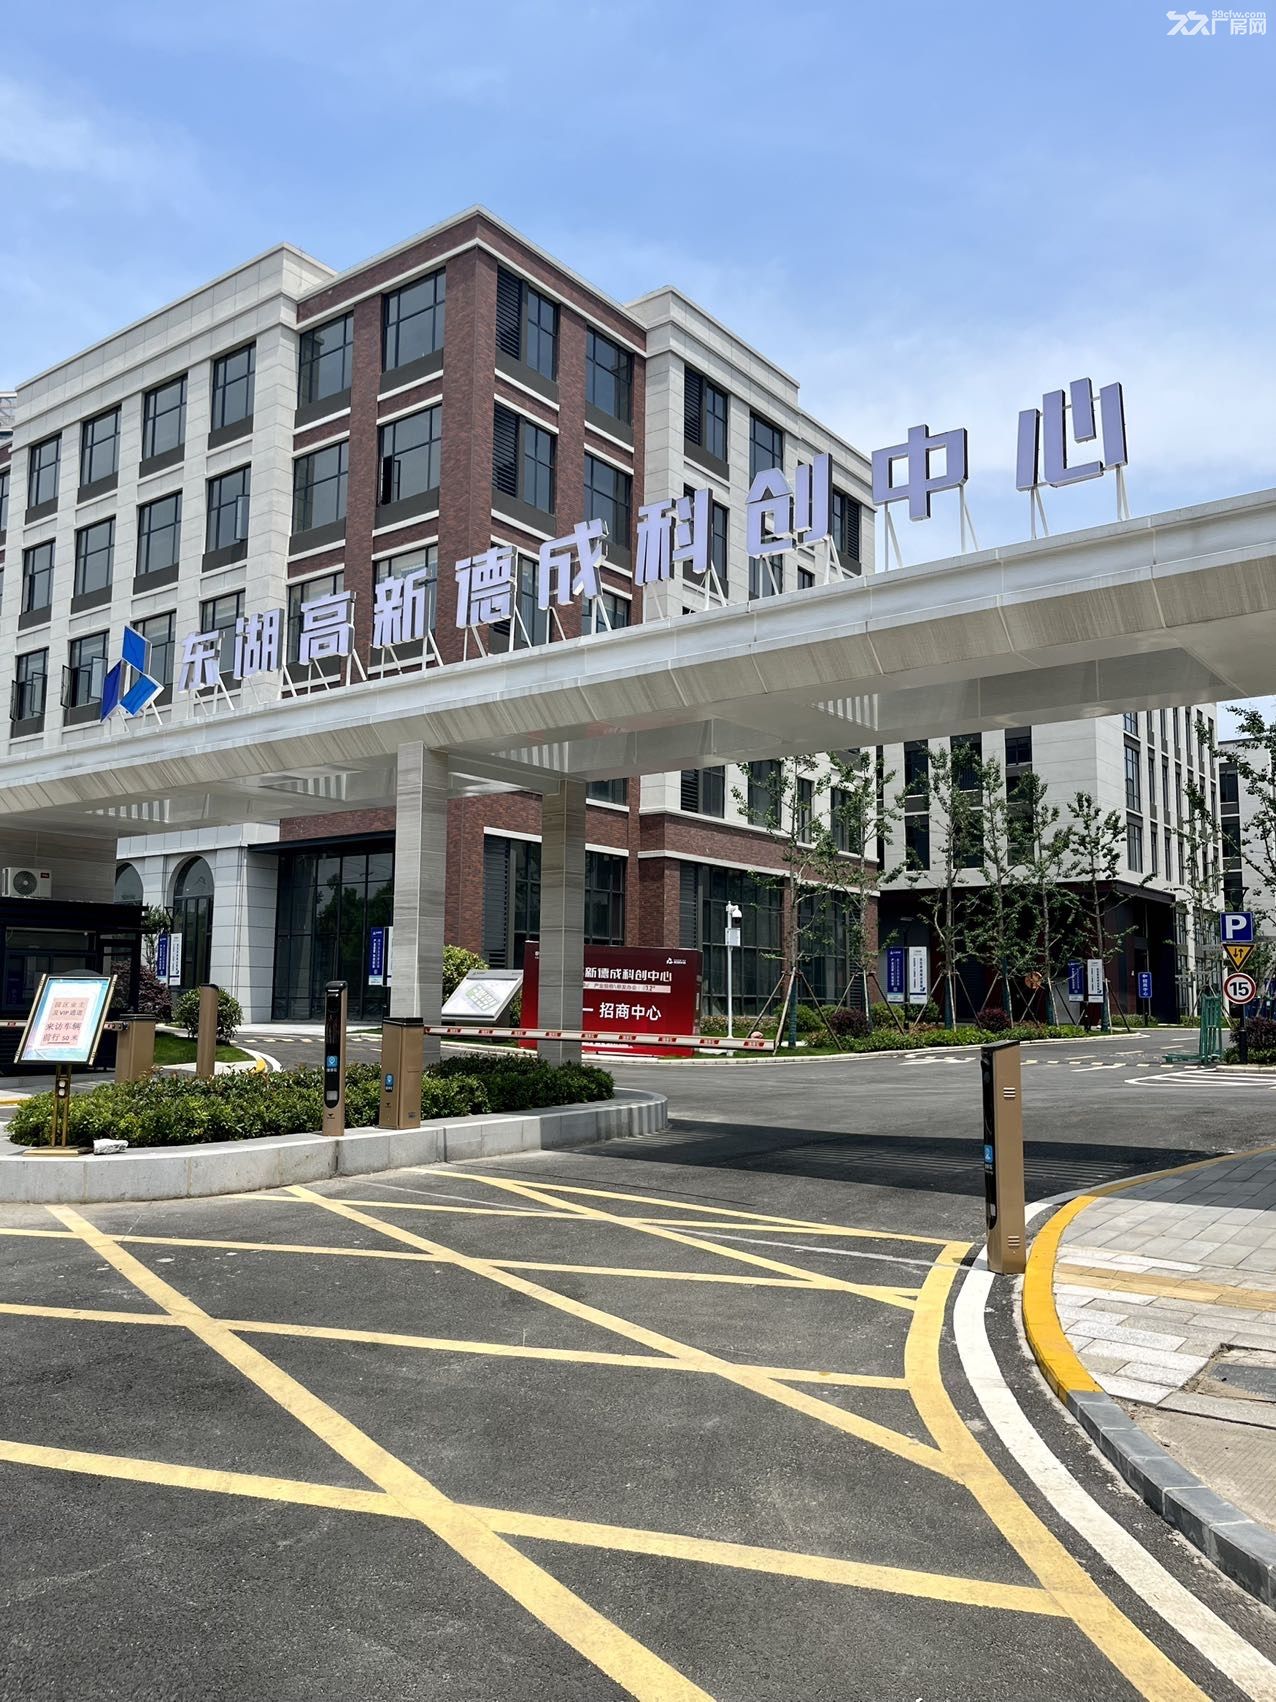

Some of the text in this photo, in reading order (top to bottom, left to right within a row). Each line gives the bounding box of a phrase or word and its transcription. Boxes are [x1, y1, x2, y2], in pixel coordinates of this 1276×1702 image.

[178, 377, 1129, 693] 东湖高新德成科创中心
[1225, 914, 1247, 939] P
[1229, 981, 1250, 997] 15
[599, 1001, 662, 1021] 招商中心
